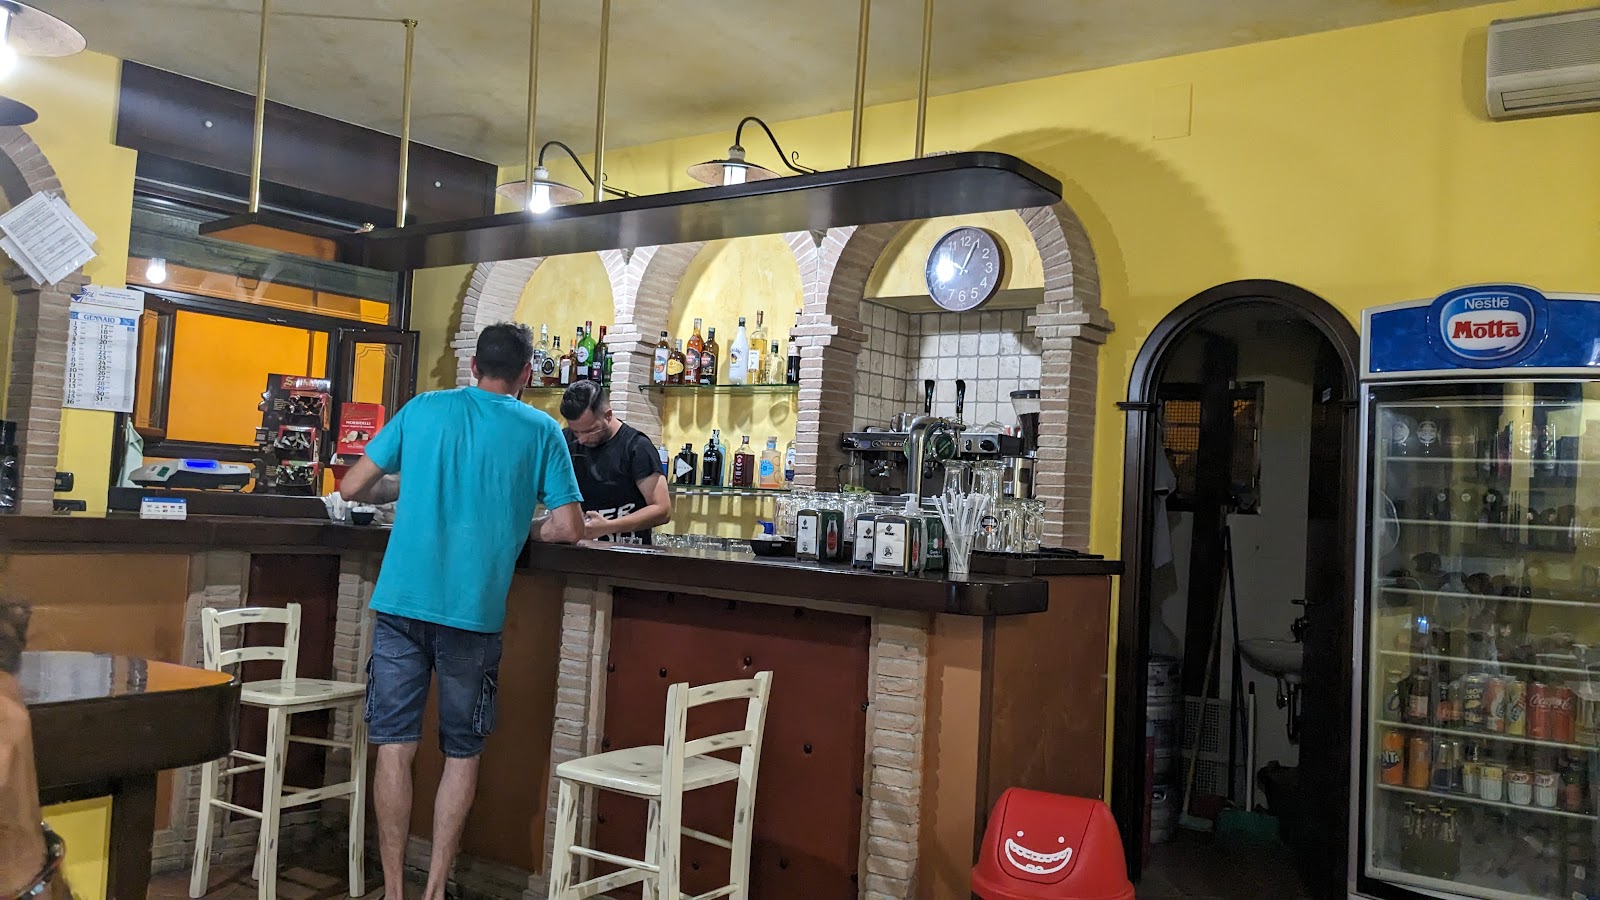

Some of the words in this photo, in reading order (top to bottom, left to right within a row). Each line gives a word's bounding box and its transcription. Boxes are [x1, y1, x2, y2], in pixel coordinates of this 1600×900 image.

[948, 241, 957, 251] 11
[960, 236, 971, 247] 12
[982, 248, 990, 259] 2
[985, 262, 993, 274] 3
[980, 276, 988, 288] 4
[949, 288, 956, 300] 7
[958, 290, 966, 302] 6
[971, 287, 979, 299] 5
[1464, 296, 1510, 310] Nestlé
[83, 314, 116, 324] GENNAIO
[1452, 319, 1522, 339] Motta
